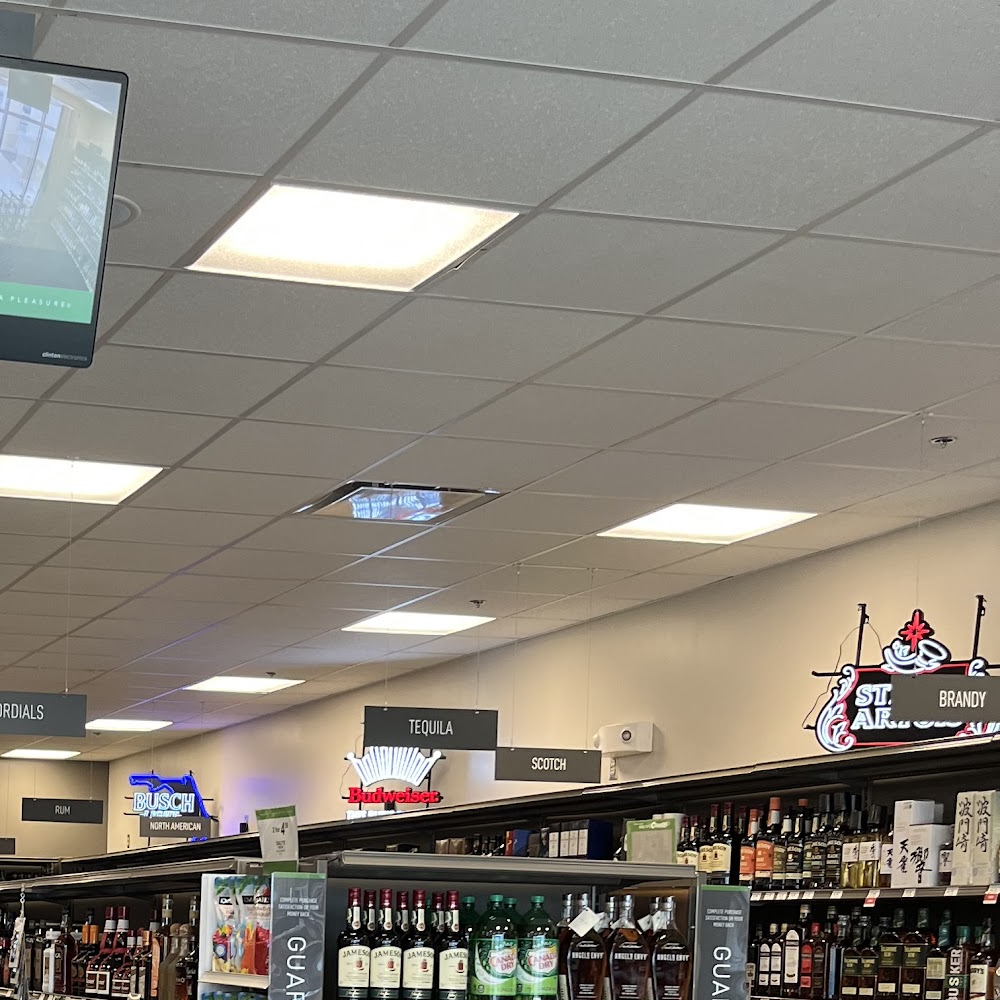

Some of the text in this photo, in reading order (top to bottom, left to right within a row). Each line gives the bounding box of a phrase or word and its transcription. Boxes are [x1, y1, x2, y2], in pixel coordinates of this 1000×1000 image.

[938, 690, 987, 709] BRANDY
[408, 718, 454, 737] TEQUILA
[531, 756, 567, 772] SCOTCH
[132, 792, 196, 813] BUSCH
[54, 805, 72, 816] RUM
[149, 821, 202, 832] NORTH AMERICAN
[342, 949, 370, 958] JAMESO
[374, 949, 401, 958] JAMESO
[407, 950, 434, 960] JAMESO
[444, 951, 468, 960] JAMES
[489, 954, 517, 967] CANAD
[538, 962, 553, 970] DRY
[501, 963, 515, 971] DRY
